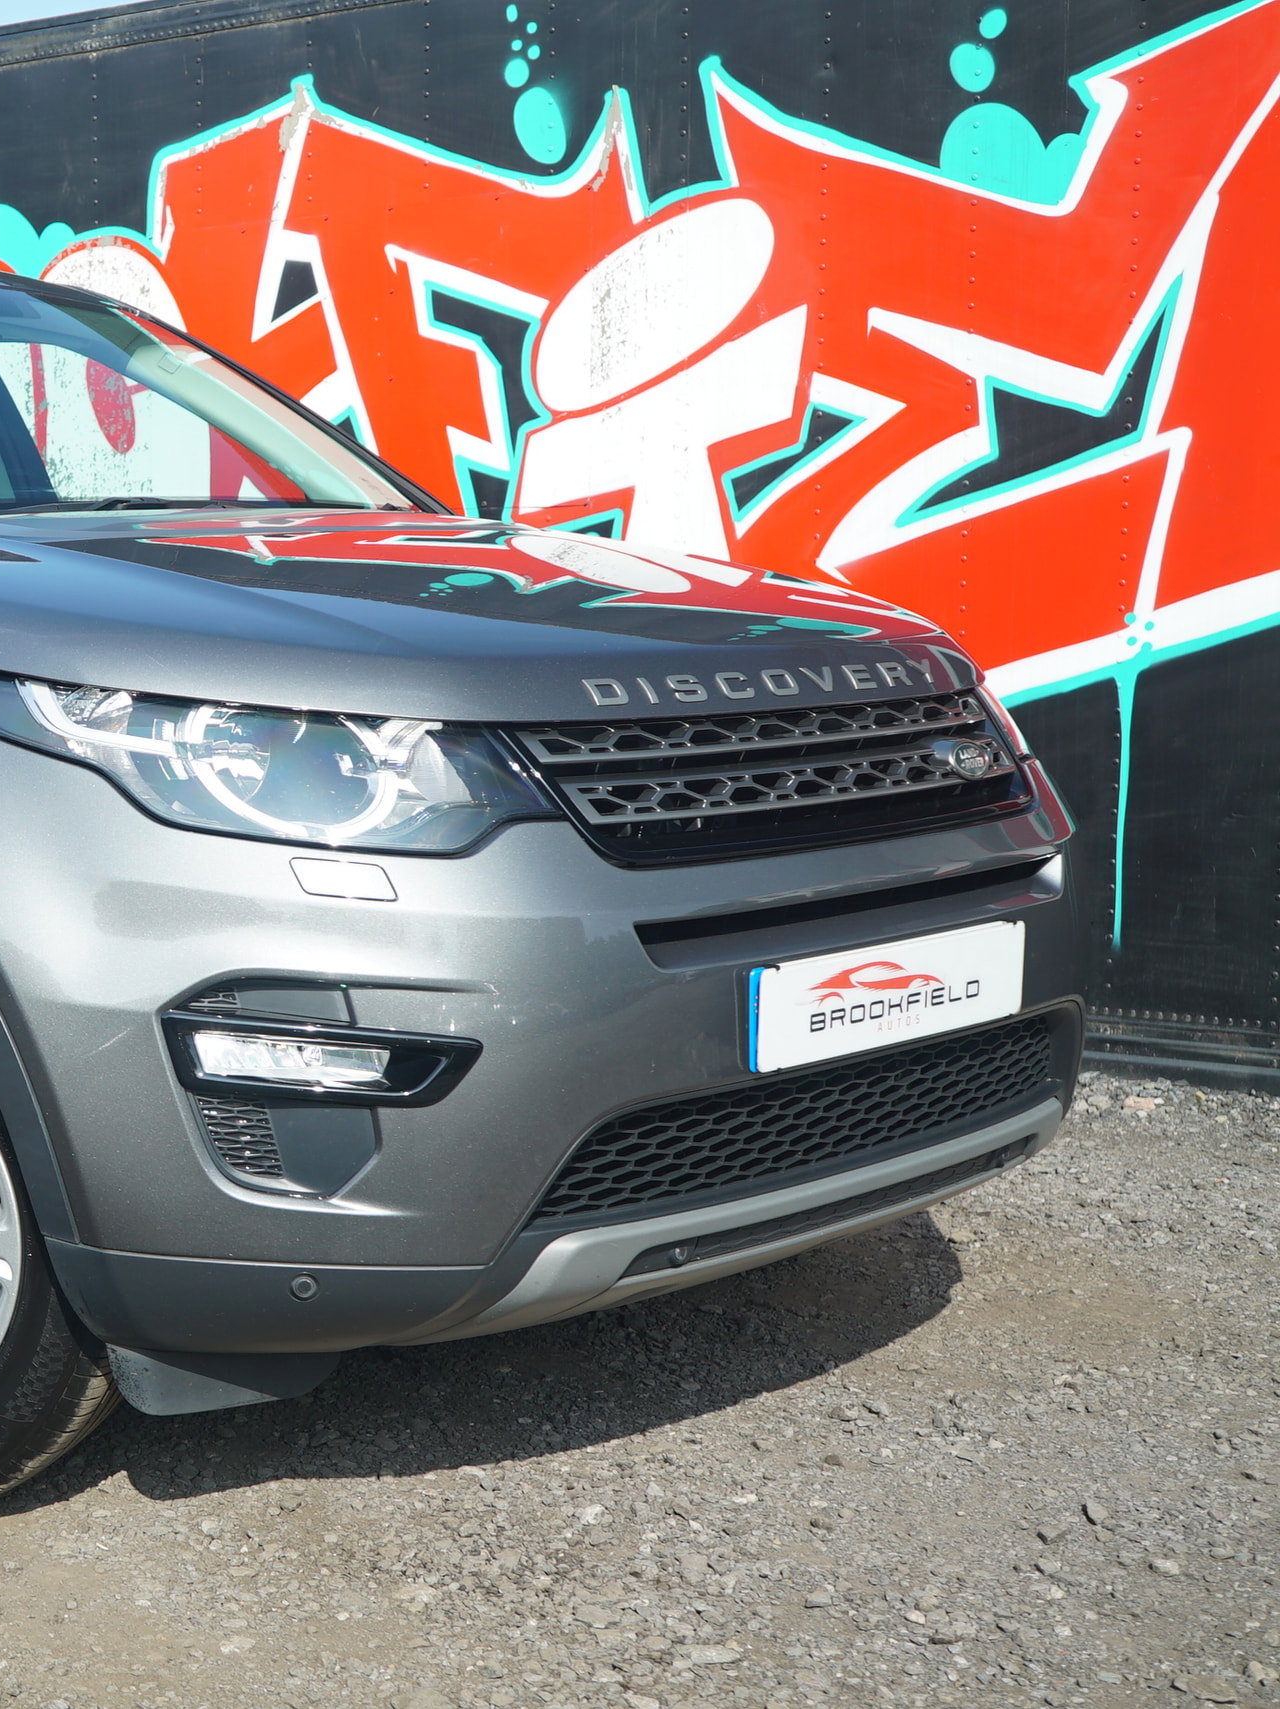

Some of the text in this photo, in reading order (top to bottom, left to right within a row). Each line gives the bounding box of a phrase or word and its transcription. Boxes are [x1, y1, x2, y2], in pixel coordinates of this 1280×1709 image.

[581, 658, 937, 707] DISCOVERY
[809, 979, 981, 1033] BROOKFIELD
[877, 1015, 921, 1033] AUTOS
